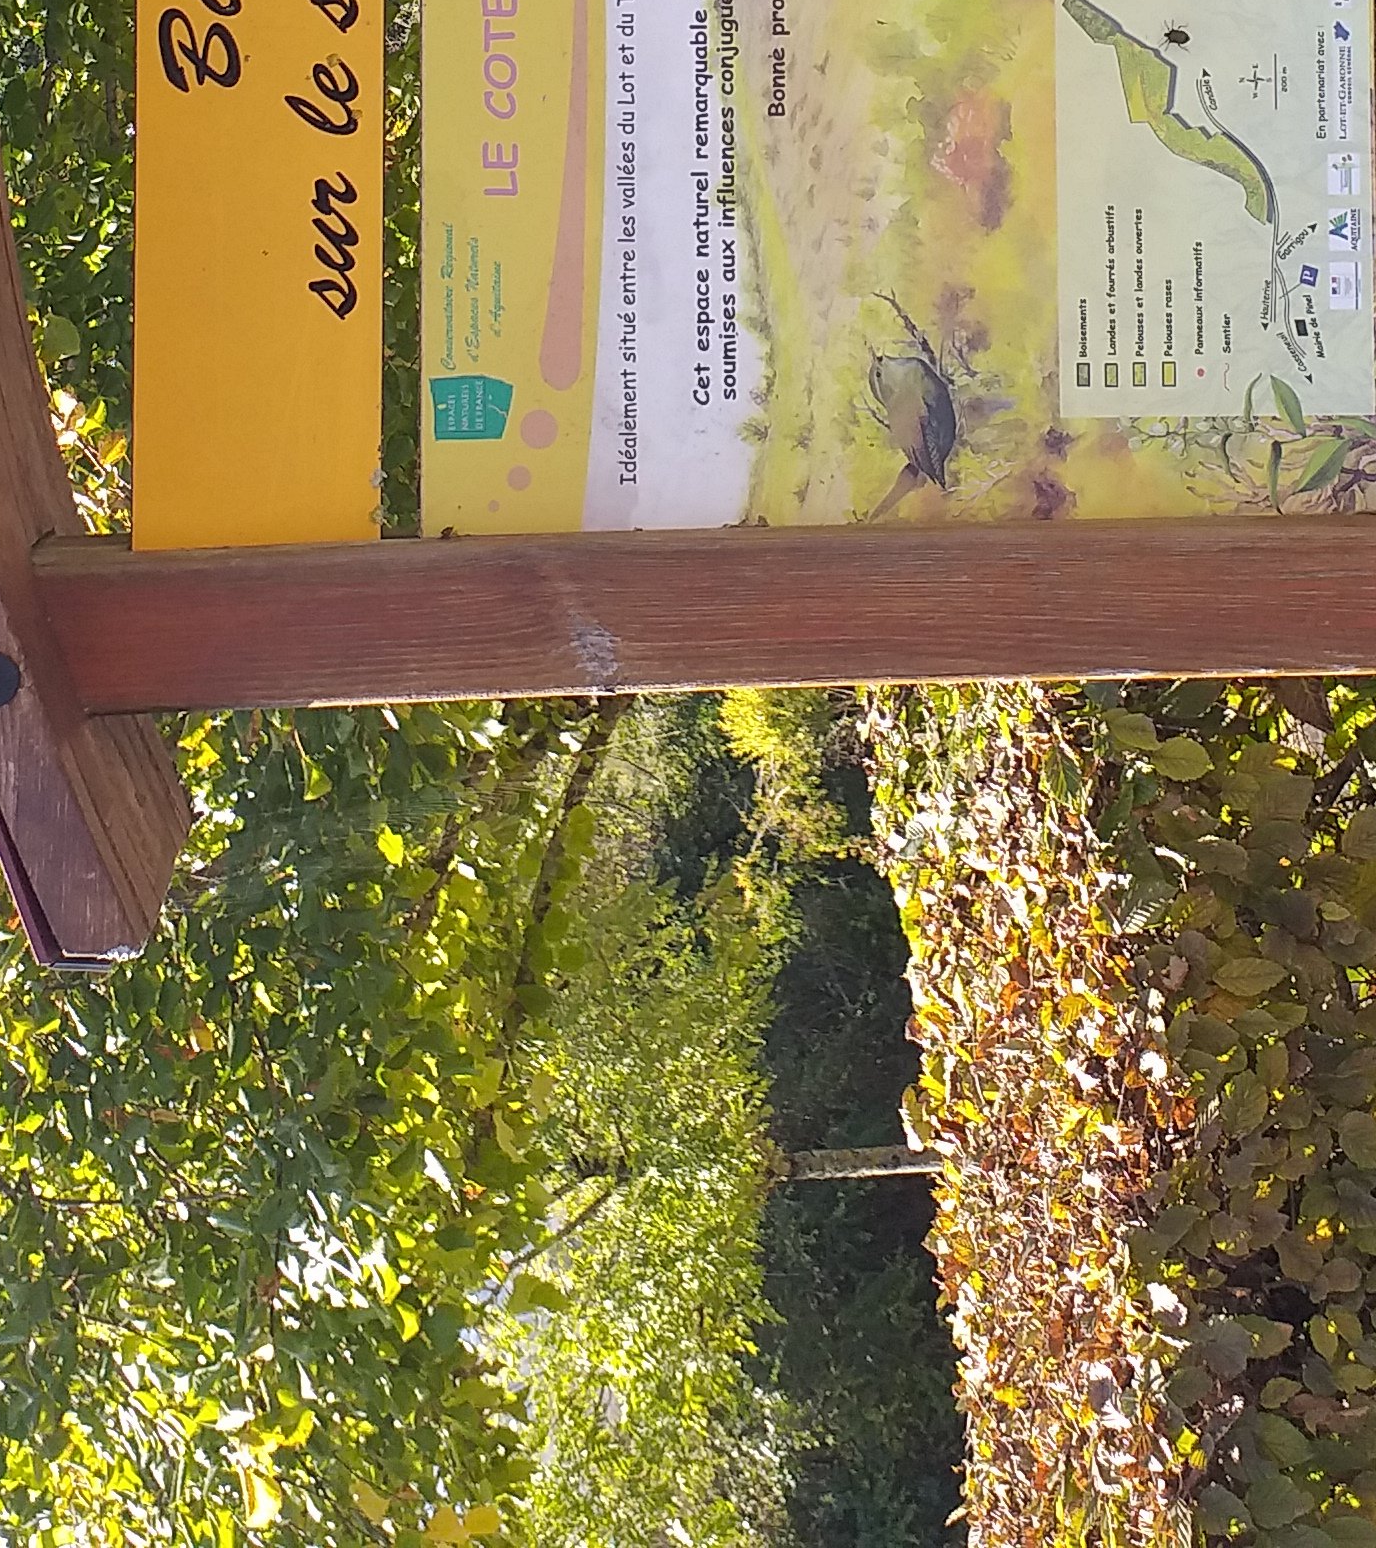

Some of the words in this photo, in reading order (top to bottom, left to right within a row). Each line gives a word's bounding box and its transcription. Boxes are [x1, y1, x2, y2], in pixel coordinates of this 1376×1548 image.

[616, 14, 634, 36] du
[1318, 31, 1326, 56] avec
[618, 43, 634, 65] et
[285, 61, 361, 135] le
[617, 72, 635, 104] Lot
[689, 10, 713, 159] remarquable
[768, 48, 785, 117] Bonne
[1316, 59, 1329, 122] partenariat
[617, 112, 635, 134] du
[1316, 125, 1328, 139] En
[482, 142, 518, 196] LE
[616, 142, 636, 209] vallées
[717, 107, 736, 227] influences
[617, 216, 635, 242] les
[690, 172, 709, 257] naturel
[1105, 205, 1115, 254] arbustifs
[1134, 209, 1143, 254] ouvertes
[1351, 209, 1359, 251] AQUITAINE
[309, 171, 361, 319] sur
[722, 239, 735, 282] aux
[620, 249, 636, 305] entre
[1105, 258, 1116, 298] fourrés
[1133, 259, 1143, 292] landes
[1192, 242, 1203, 301] informatifs
[696, 269, 715, 351] espace
[1107, 303, 1116, 314] et
[1134, 297, 1143, 308] et
[1164, 279, 1173, 308] rases
[1261, 280, 1271, 320] Hauterive
[1303, 294, 1315, 315] Pinel
[617, 311, 636, 363] situé
[1078, 299, 1088, 357] Boisements
[1106, 318, 1117, 356] Landes
[1133, 312, 1144, 357] Pelouses
[1163, 312, 1173, 357] Pelouses
[1193, 305, 1204, 355] Panneaux
[1221, 313, 1232, 354] Sentier
[1307, 317, 1318, 328] de
[719, 294, 736, 400] soumises
[1276, 332, 1307, 372] Casseneuil
[1310, 330, 1326, 358] Mairie
[693, 363, 710, 405] Cet
[447, 395, 456, 431] ESPACES
[617, 369, 637, 485] Idéalement
